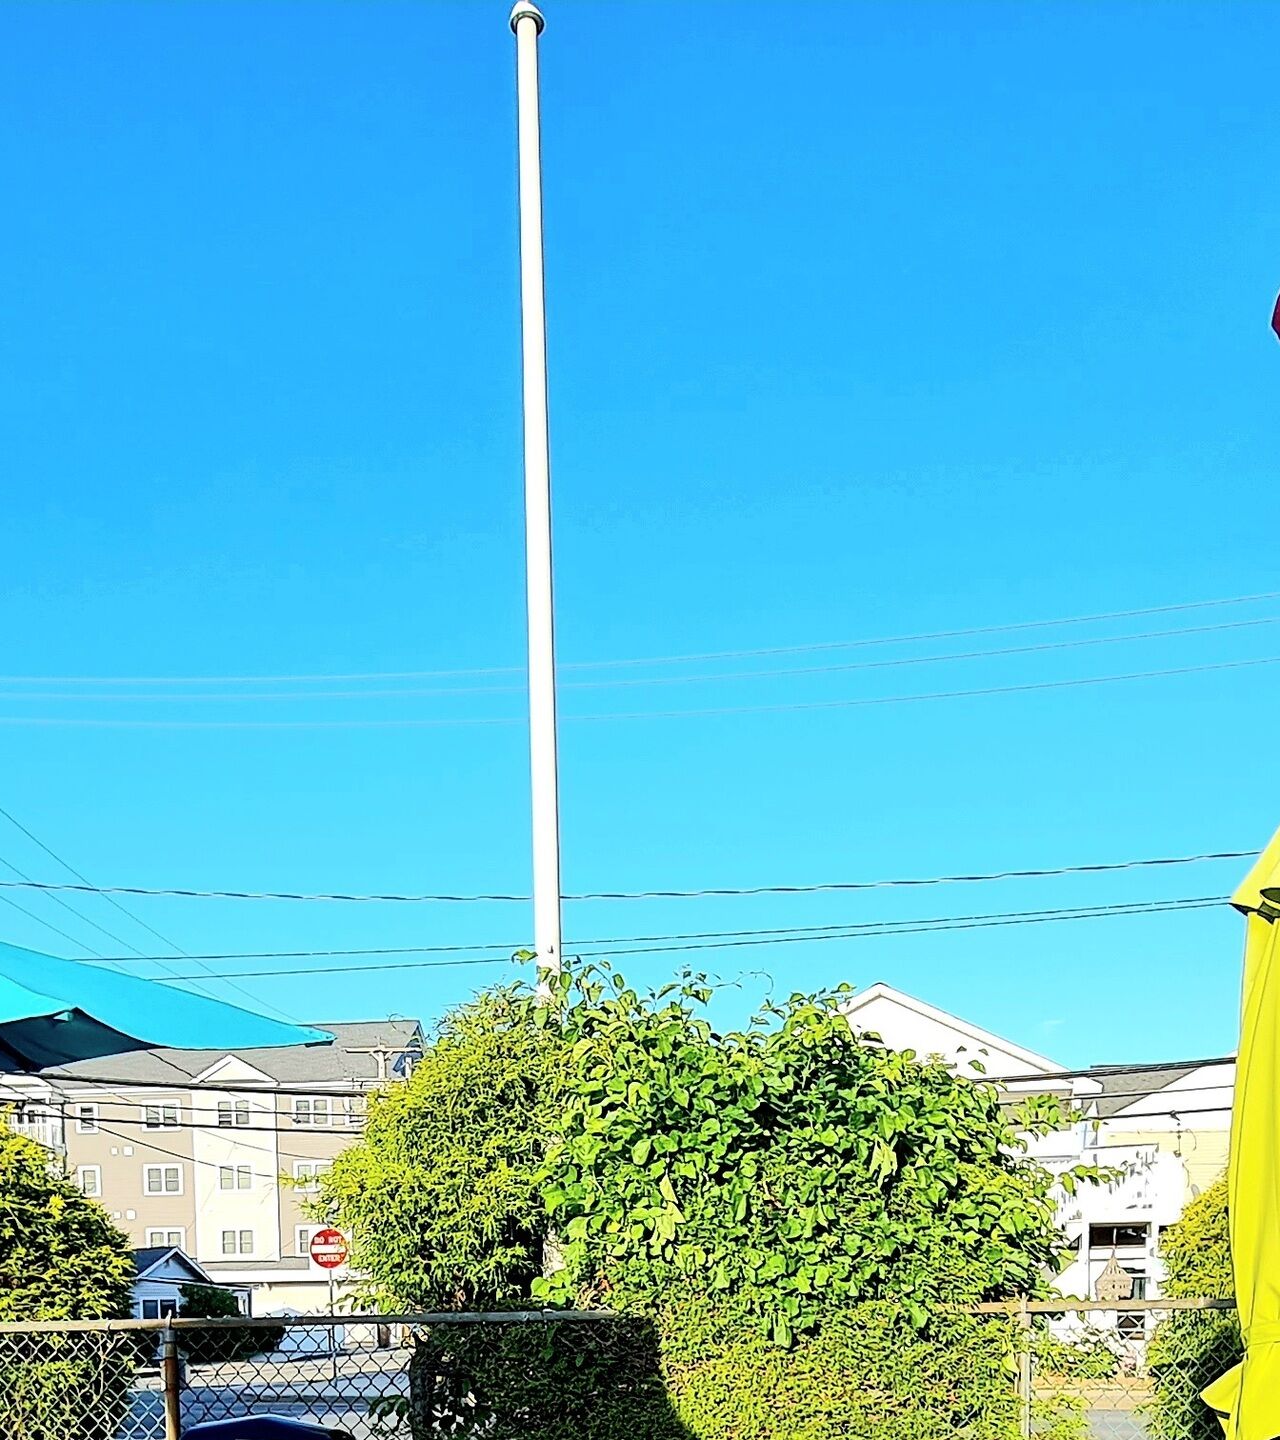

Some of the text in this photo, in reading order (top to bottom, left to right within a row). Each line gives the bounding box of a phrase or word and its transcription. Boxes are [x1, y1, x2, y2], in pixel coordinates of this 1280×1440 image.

[314, 1235, 341, 1244] DO NOT
[318, 1254, 341, 1262] ENTER
